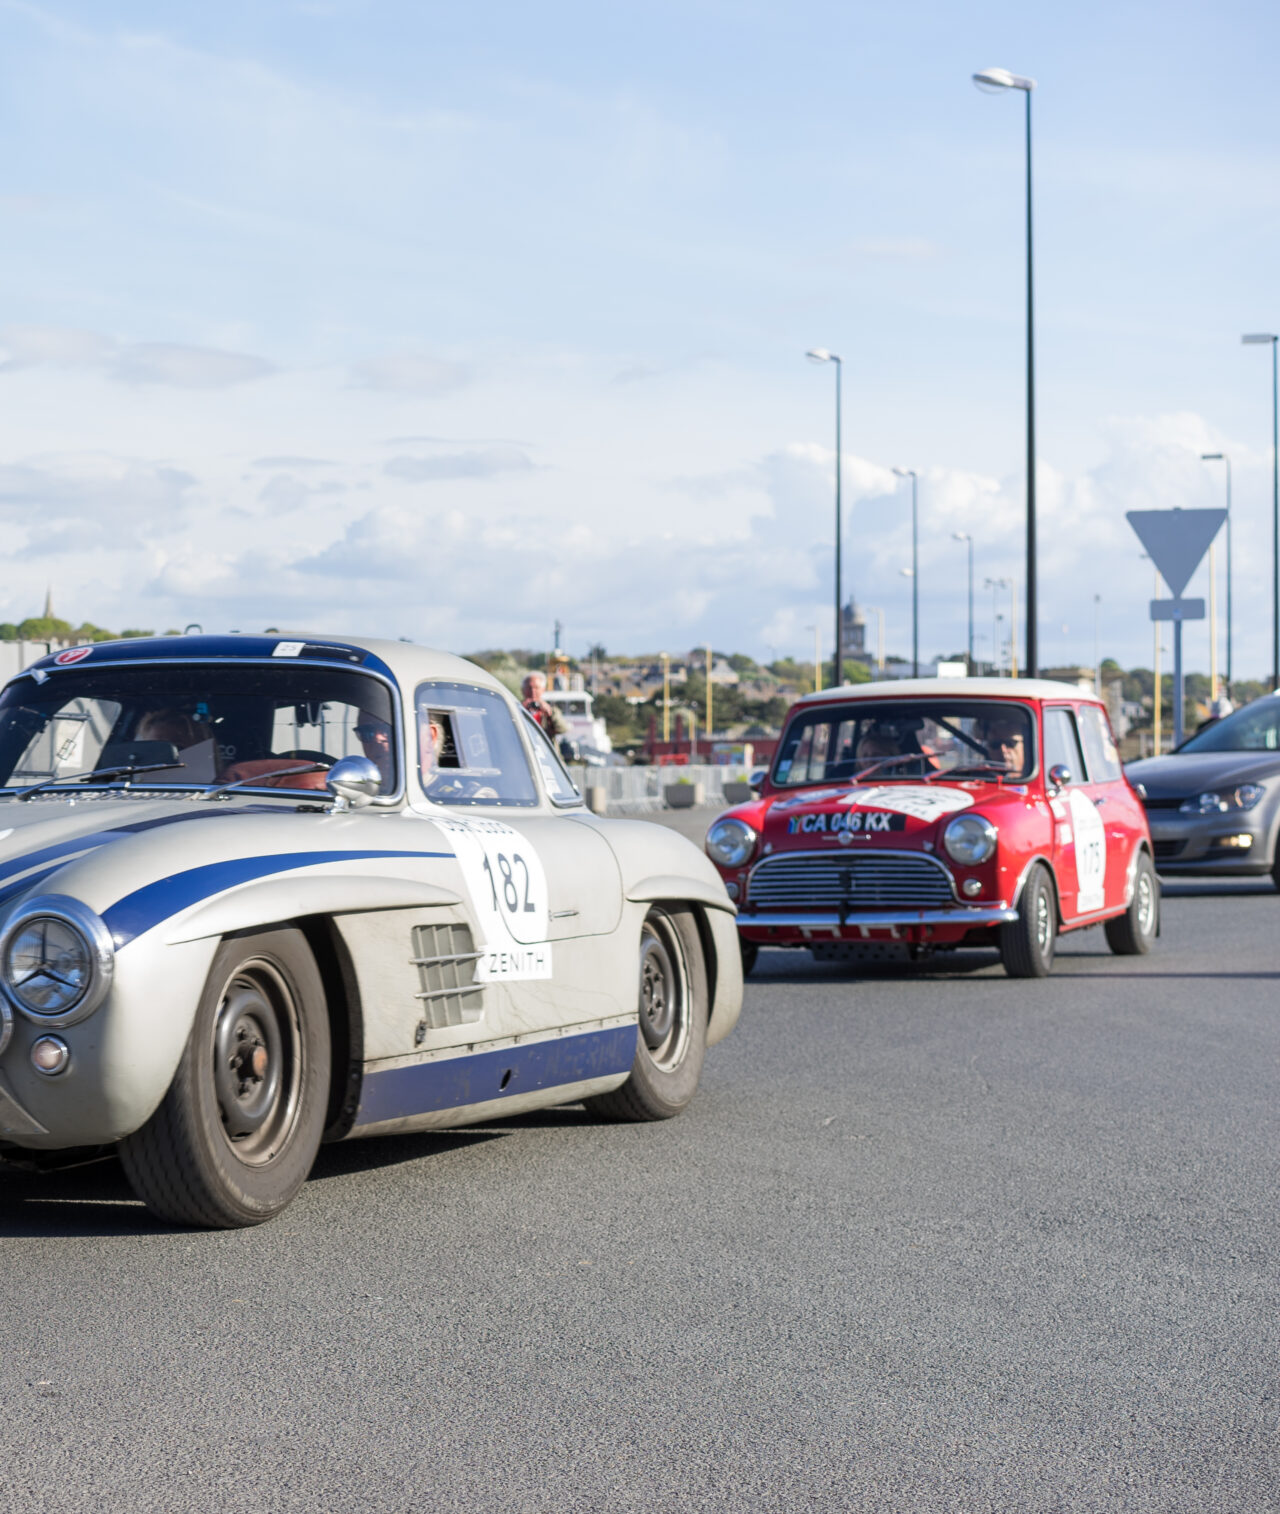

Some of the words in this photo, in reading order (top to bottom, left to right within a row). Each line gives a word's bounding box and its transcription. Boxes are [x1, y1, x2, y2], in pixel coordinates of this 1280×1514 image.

[865, 812, 891, 831] KX
[483, 853, 535, 913] 182
[489, 952, 545, 973] ZENITH
